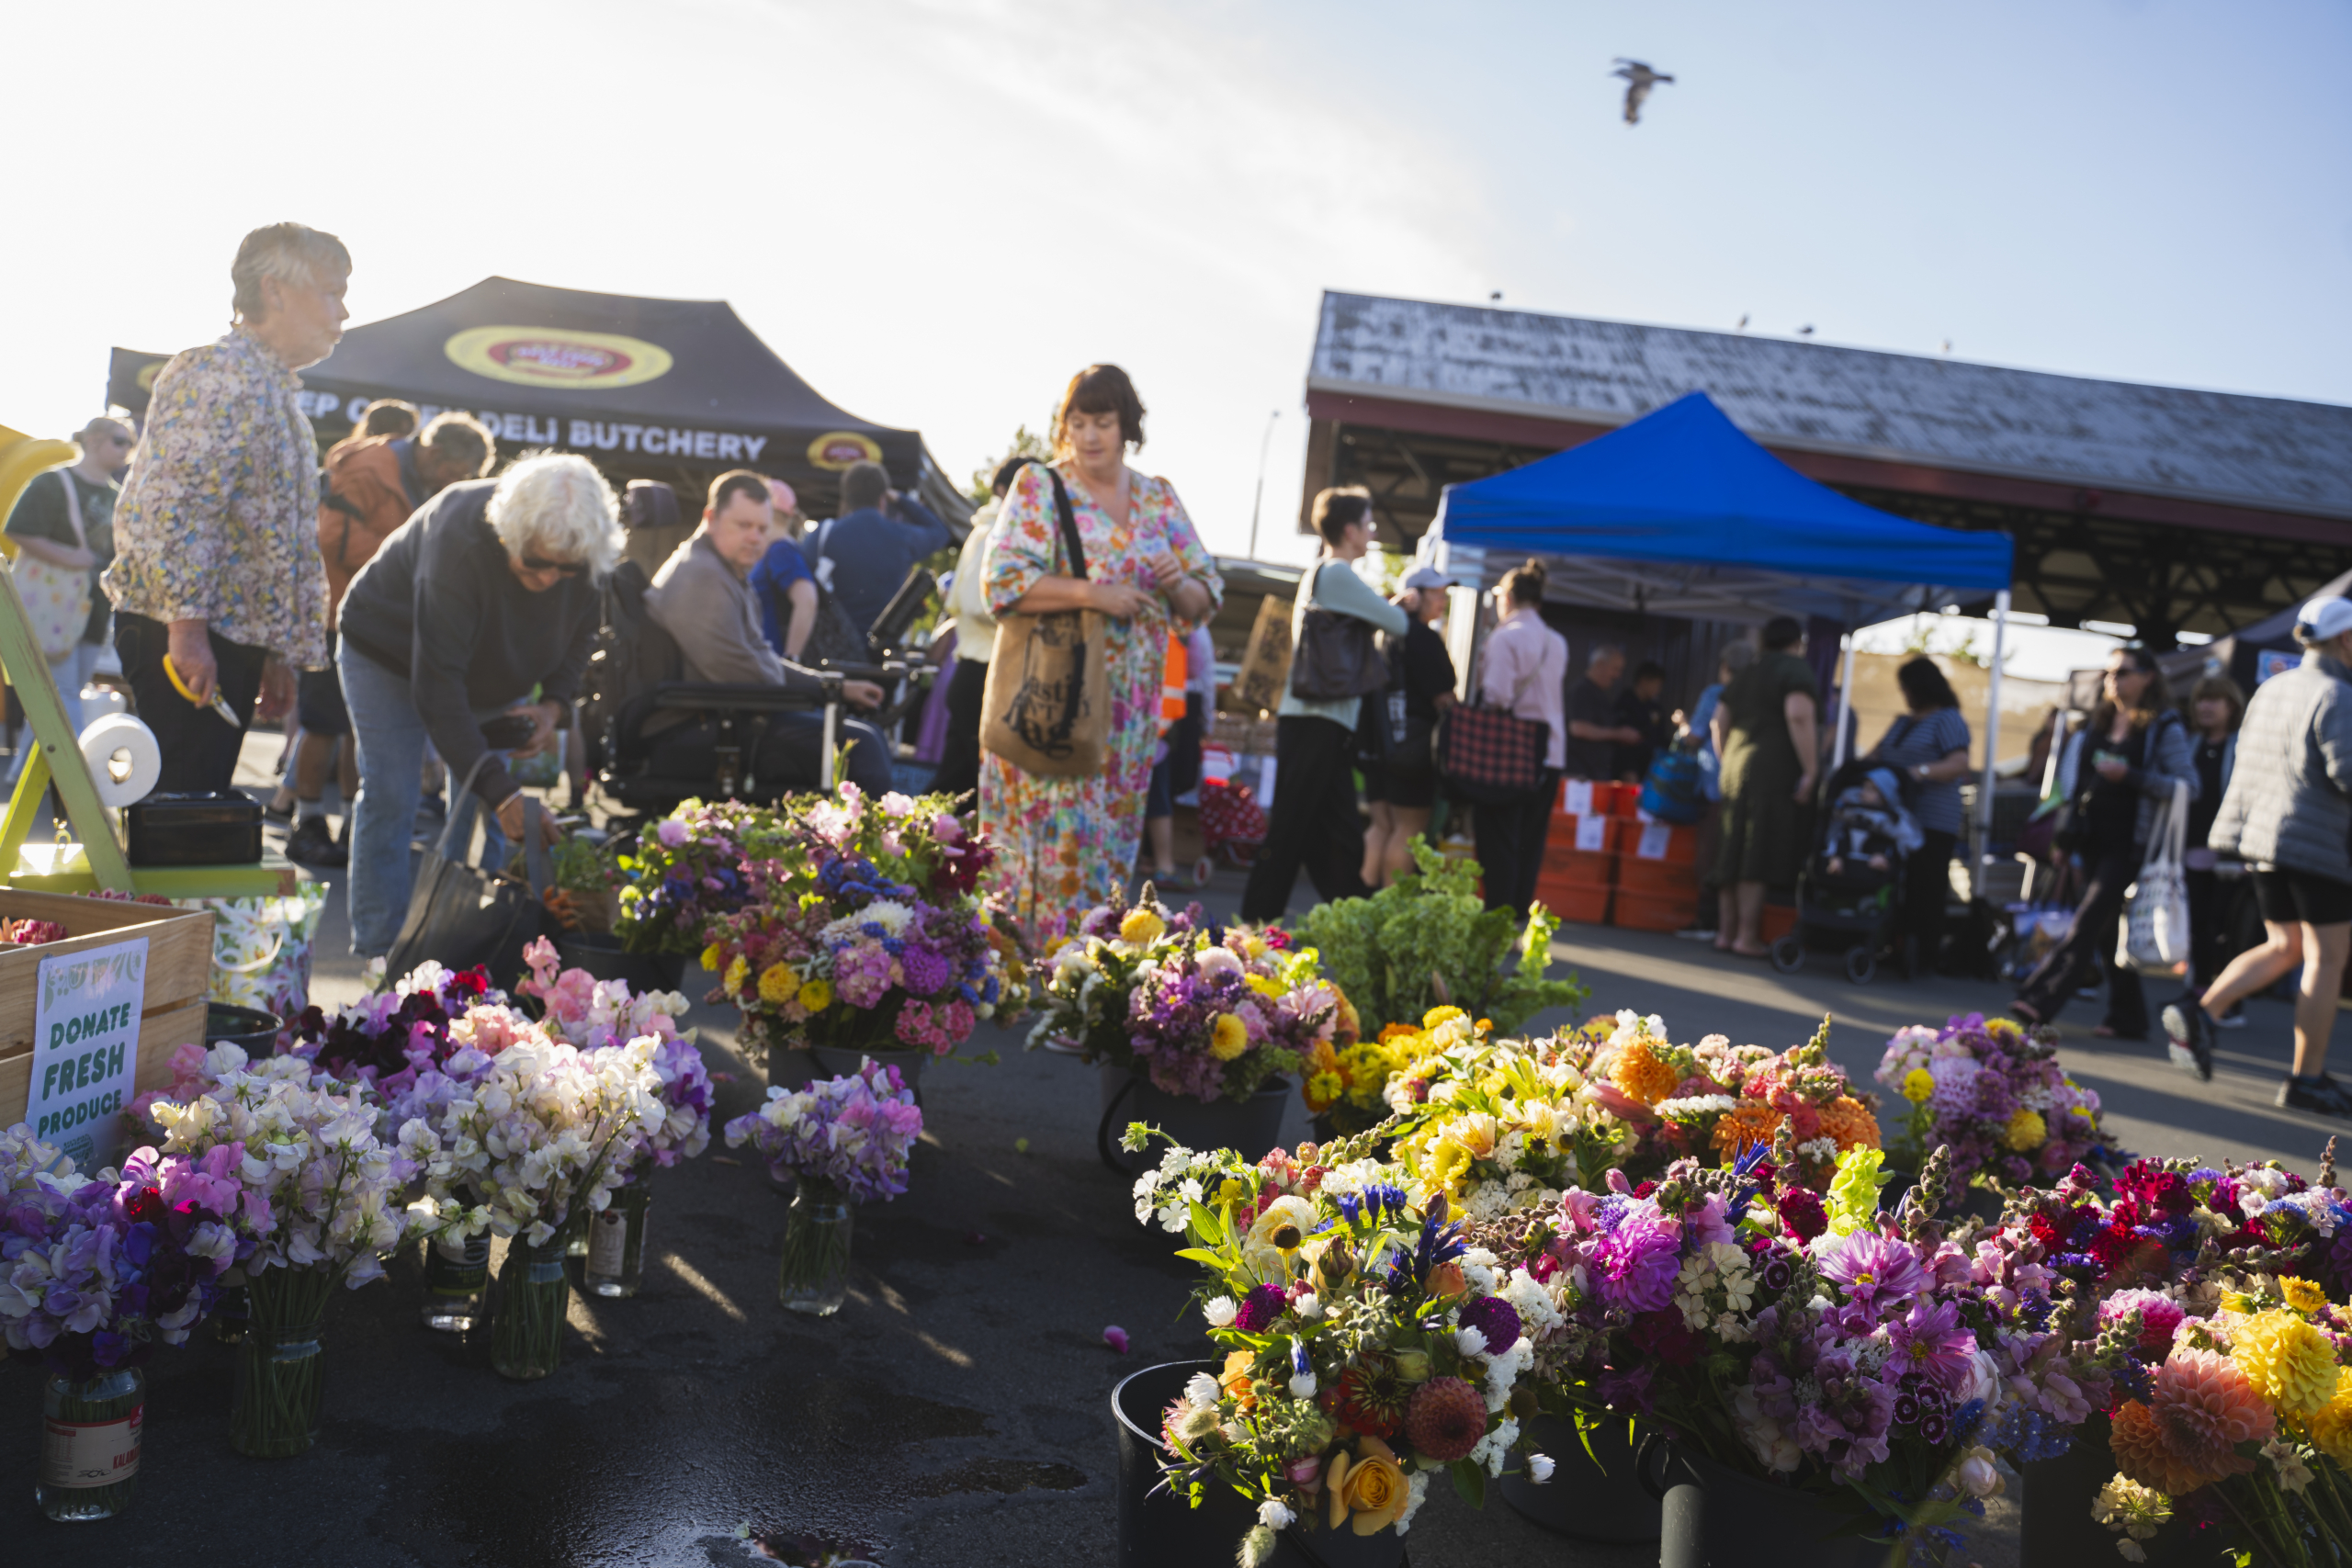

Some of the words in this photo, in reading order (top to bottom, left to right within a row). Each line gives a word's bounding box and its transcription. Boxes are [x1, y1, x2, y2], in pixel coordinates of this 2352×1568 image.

[300, 389, 341, 420] EP
[479, 411, 560, 446] DELI
[570, 420, 767, 463] BUTCHERY
[50, 1002, 131, 1051] DONATE
[41, 1041, 126, 1101] FRESH
[38, 1088, 122, 1140] PRODUCE
